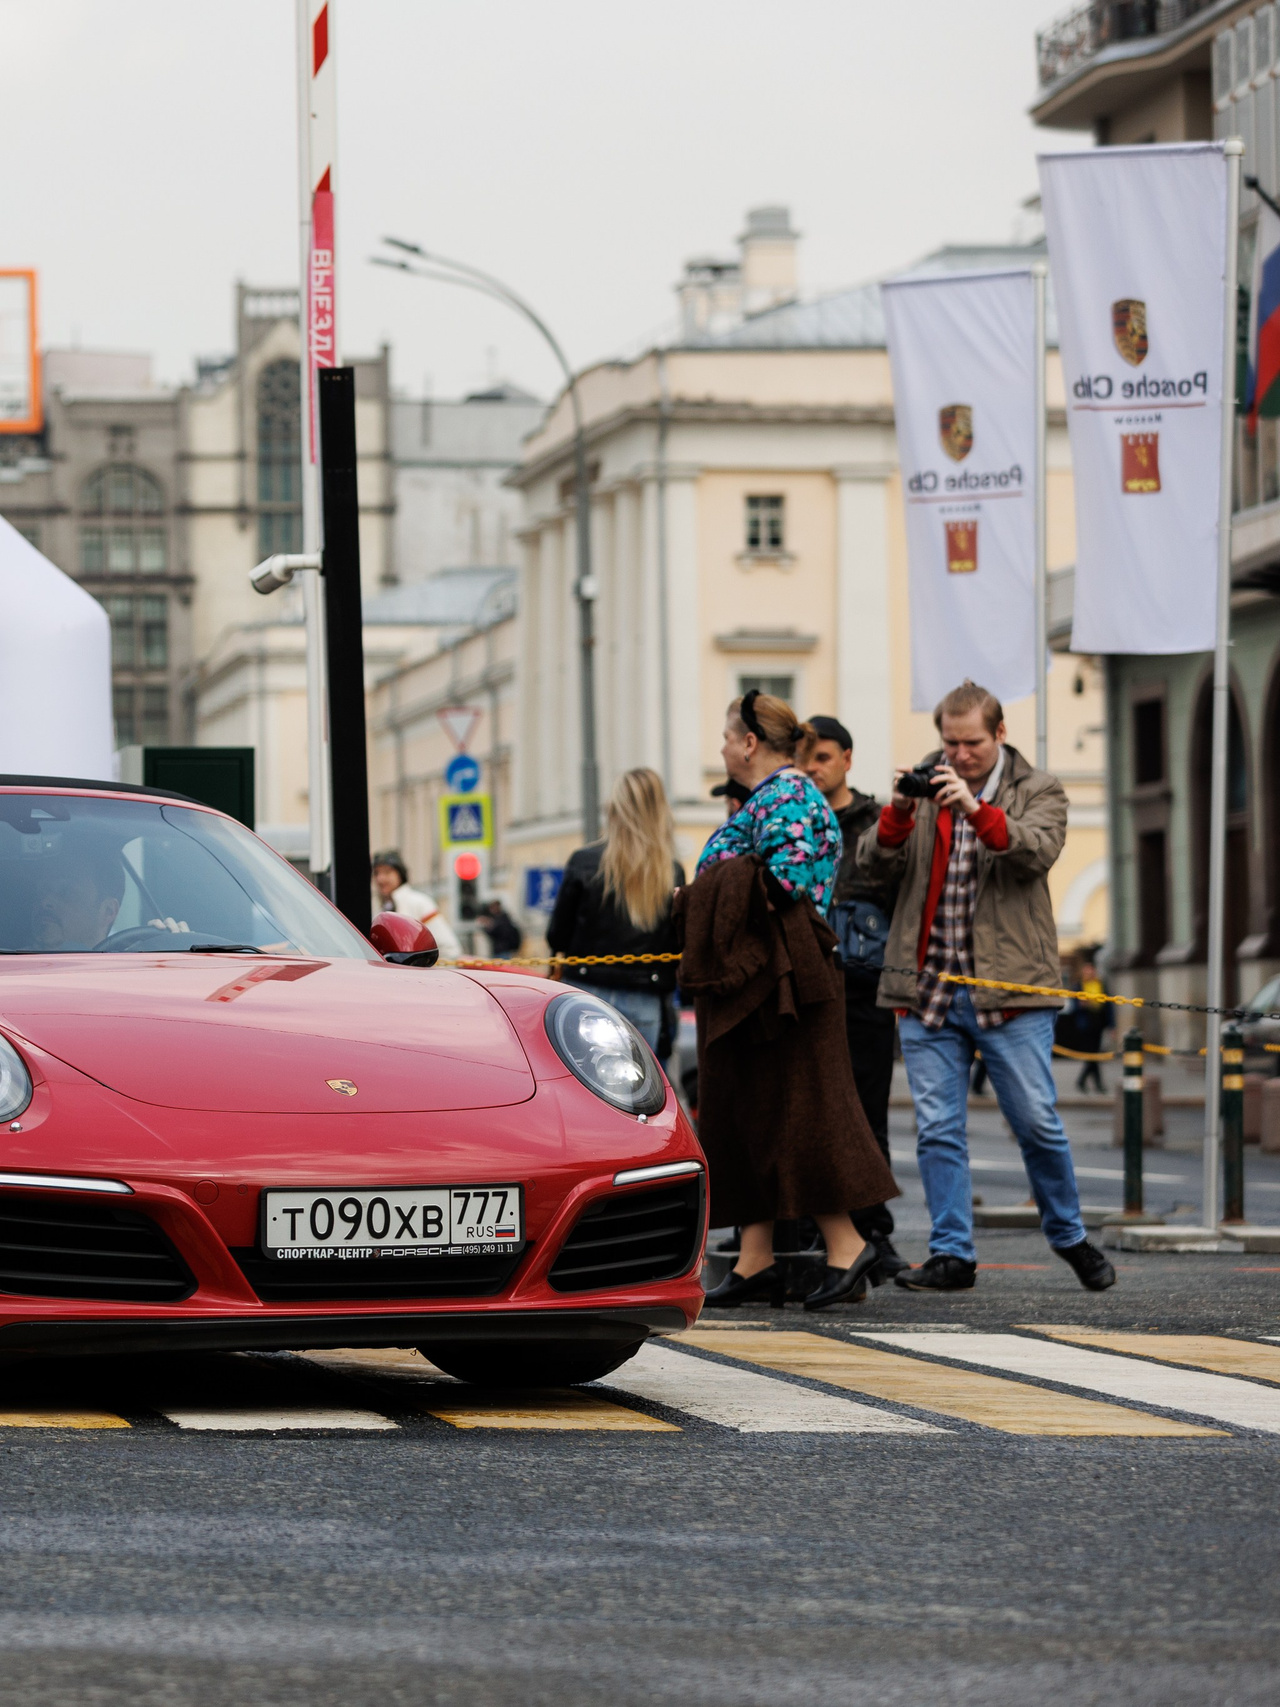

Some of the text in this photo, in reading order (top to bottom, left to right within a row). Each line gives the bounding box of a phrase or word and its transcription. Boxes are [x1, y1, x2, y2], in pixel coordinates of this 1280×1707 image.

[282, 1191, 508, 1241] Т090ХВ 777
[466, 1225, 494, 1238] RUS
[277, 1243, 513, 1260] СПОРТКАР-ЦЕНТР PORSCHE (495) 249 11 11
